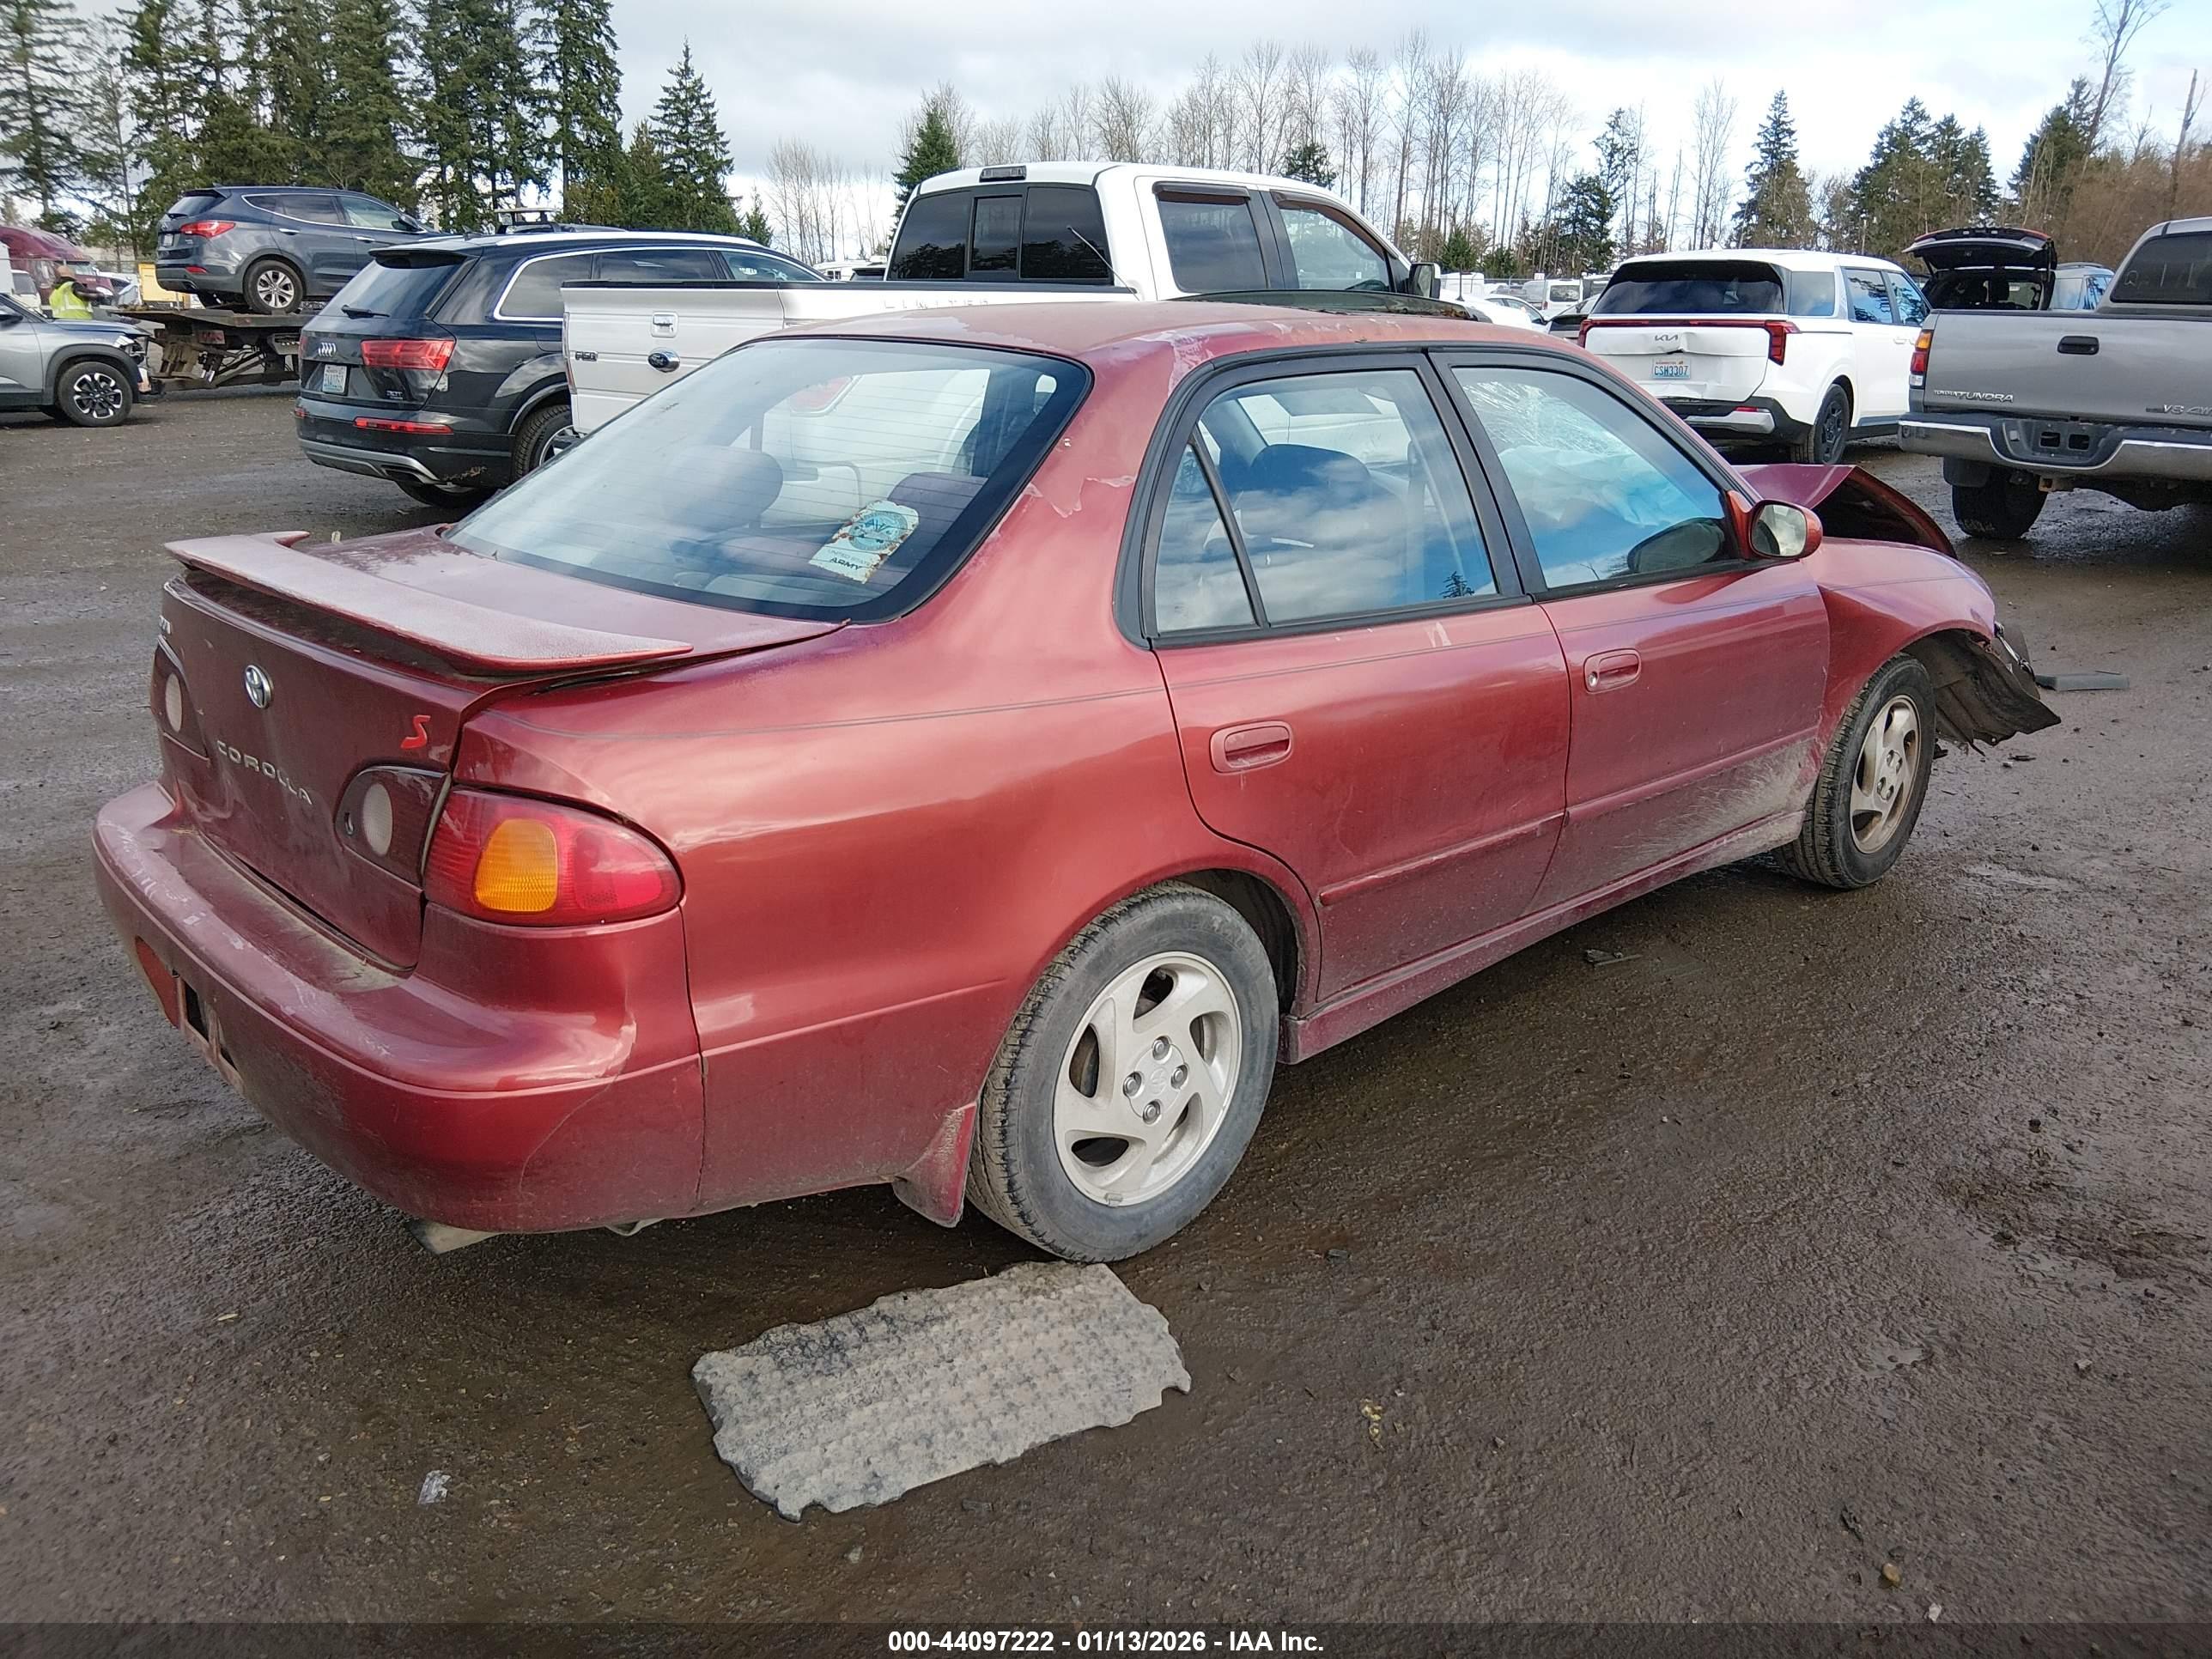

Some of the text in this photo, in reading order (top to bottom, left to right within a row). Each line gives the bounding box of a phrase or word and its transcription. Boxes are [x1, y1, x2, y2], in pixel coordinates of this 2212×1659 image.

[1654, 366, 1689, 376] CSH3307
[1957, 391, 2014, 403] TUNDRA
[830, 557, 861, 570] ARMY
[216, 739, 313, 805] COROLLA
